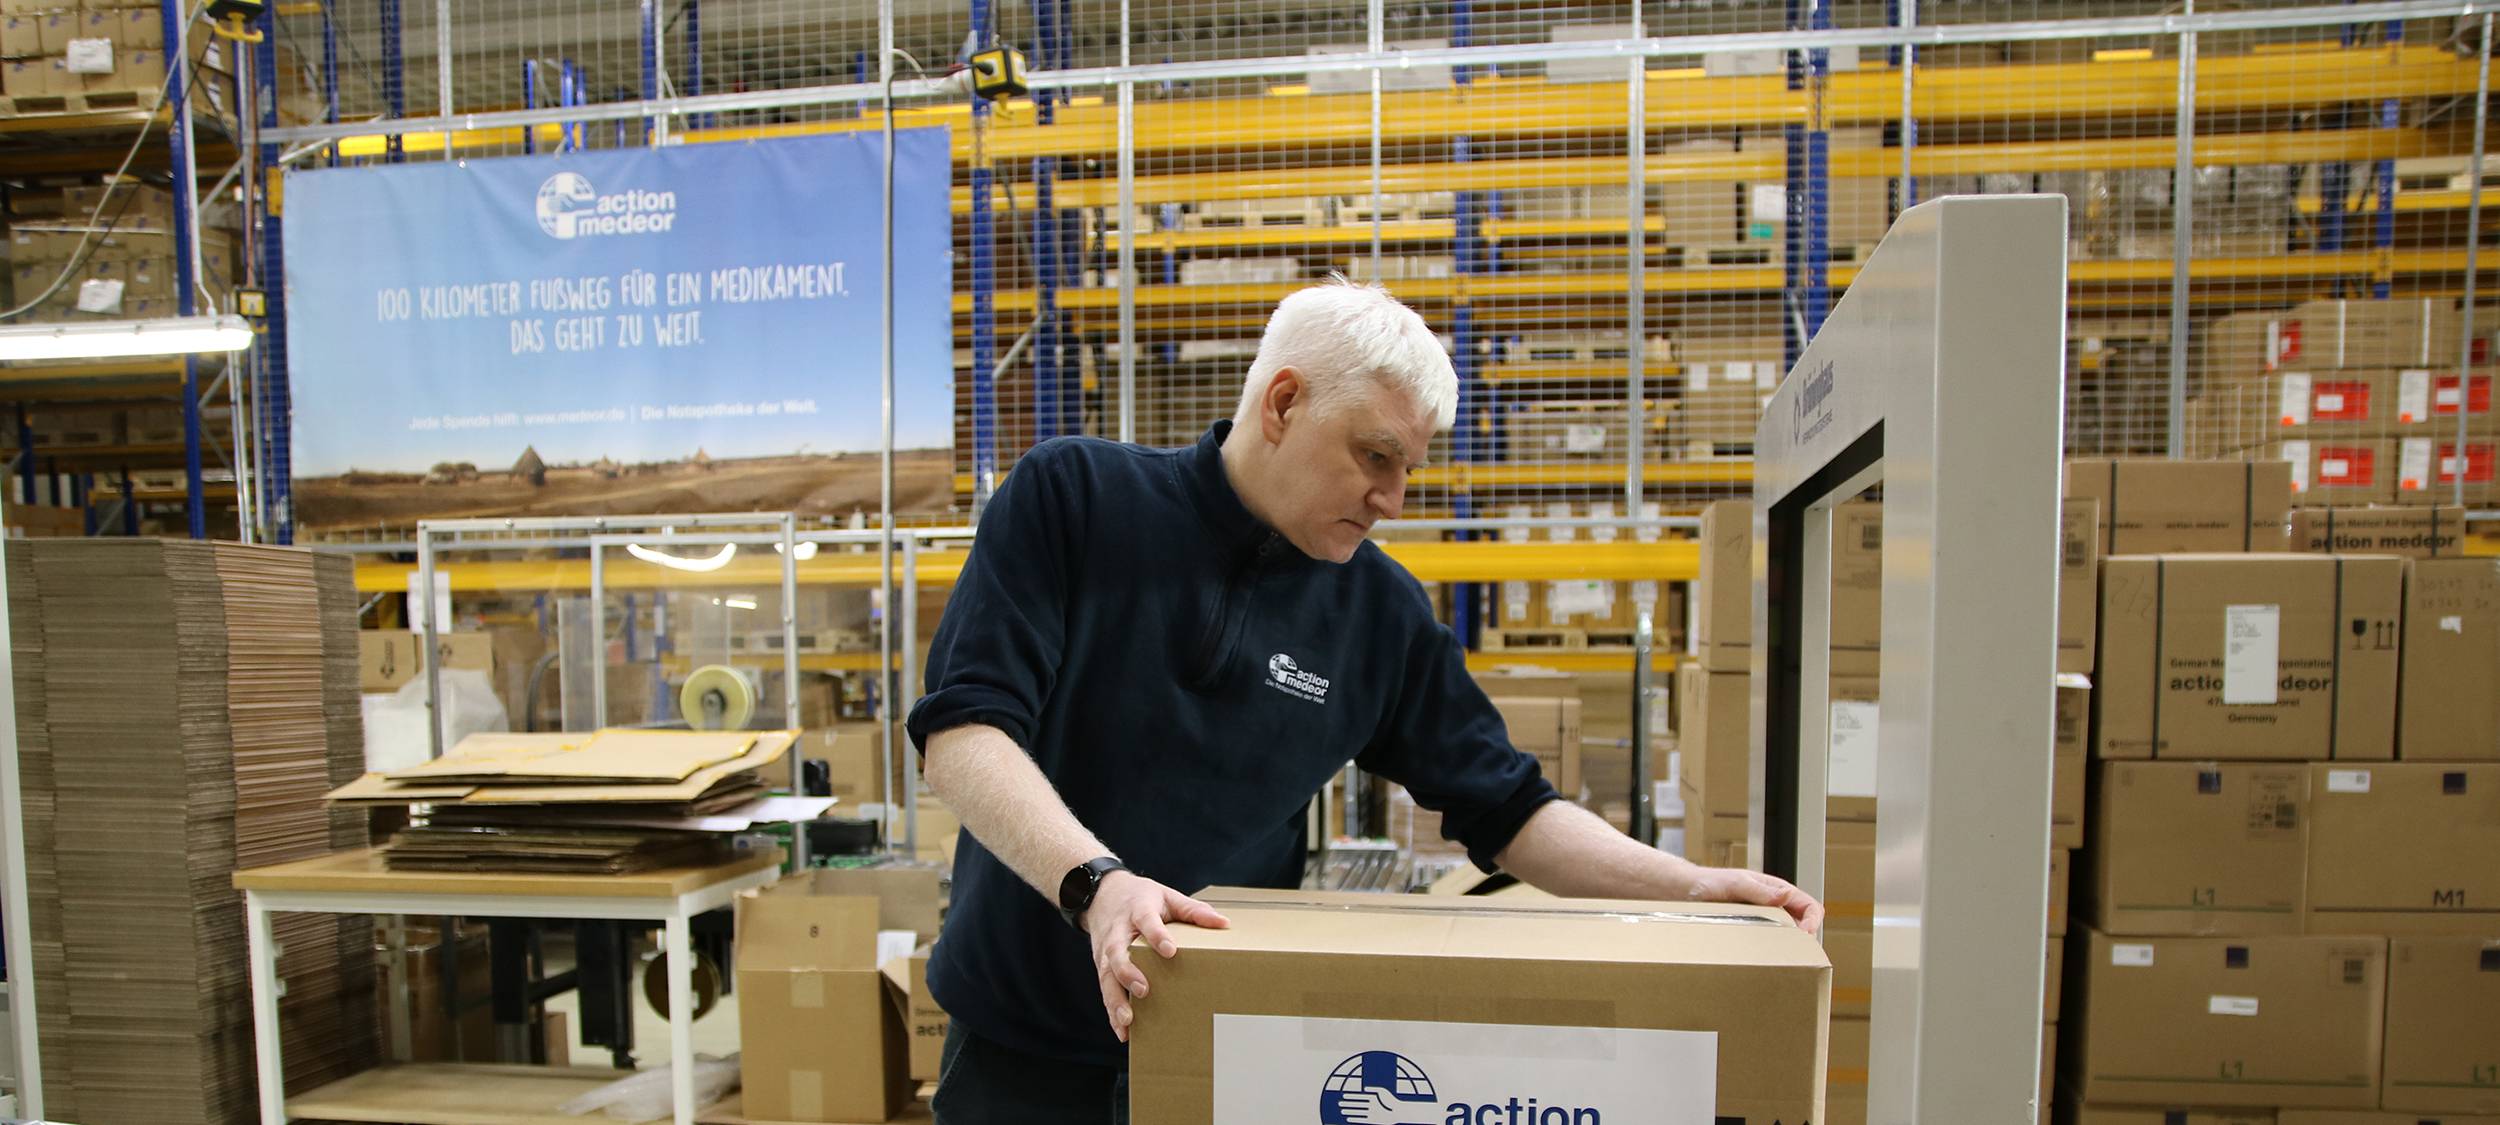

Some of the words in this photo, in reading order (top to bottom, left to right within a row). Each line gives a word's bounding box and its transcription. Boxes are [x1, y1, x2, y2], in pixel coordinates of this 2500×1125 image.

[597, 189, 676, 214] action
[578, 211, 675, 236] medeor
[378, 288, 411, 321] 100
[420, 281, 521, 320] KILOMETER
[530, 276, 611, 312] FUßWEG
[621, 269, 657, 308] FÜR
[666, 272, 701, 307] EIN
[711, 262, 849, 303] MEDIKAMENT.
[511, 318, 545, 354] DAS
[555, 316, 606, 352] GEHT
[616, 314, 643, 348] ZU
[653, 311, 704, 347] WEIT.
[641, 404, 662, 420] Die
[757, 402, 779, 416] der
[2171, 659, 2208, 669] German
[1287, 676, 1327, 696] medeor
[1297, 670, 1330, 688] action
[2170, 675, 2223, 691] actio
[2278, 675, 2331, 691] deor
[2228, 713, 2278, 724] Germany
[2433, 890, 2465, 907] M1
[1445, 1097, 1600, 1125] action
